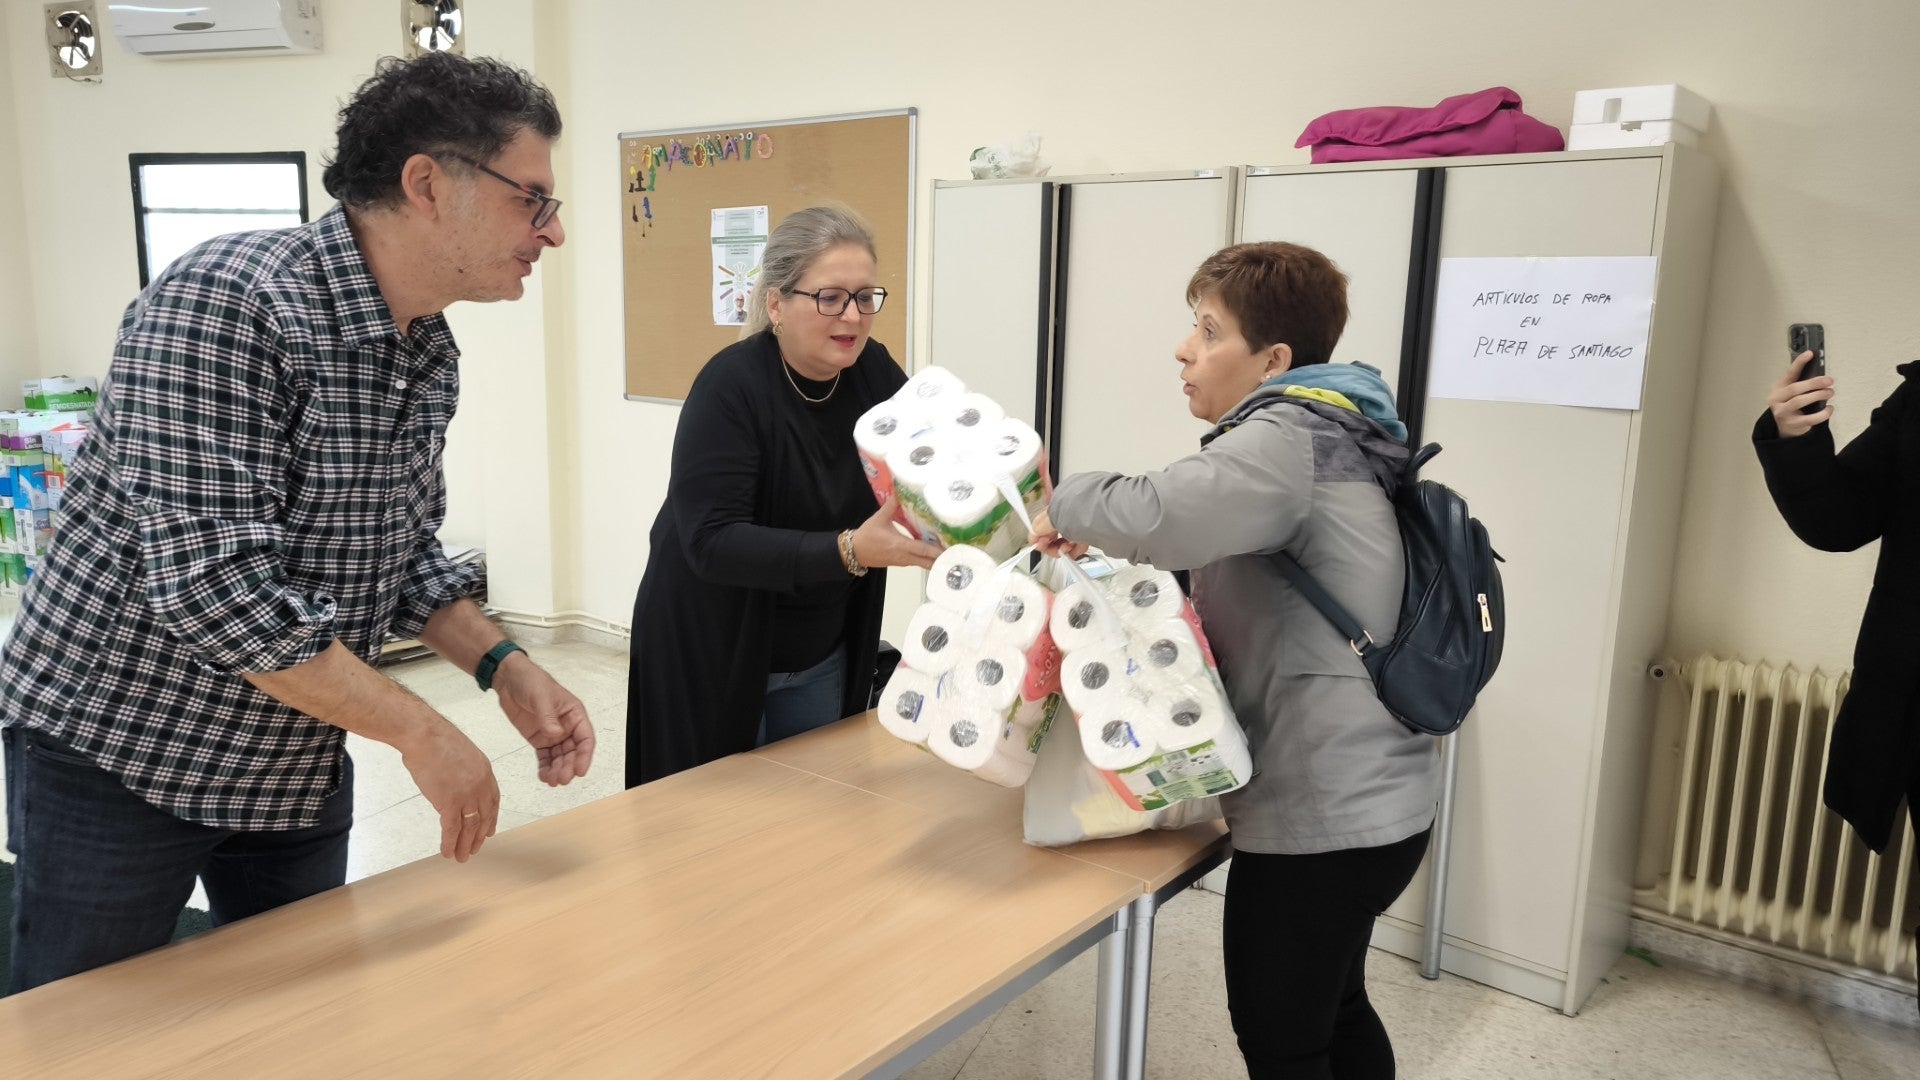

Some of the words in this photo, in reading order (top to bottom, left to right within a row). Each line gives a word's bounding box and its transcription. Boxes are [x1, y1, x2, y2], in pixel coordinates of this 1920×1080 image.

[1552, 293, 1571, 306] DE
[1581, 292, 1612, 304] ROPA
[1519, 316, 1542, 328] EN
[1473, 336, 1528, 358] PLAZA
[1537, 345, 1559, 359] DE
[1568, 343, 1634, 360] SANTIAGO
